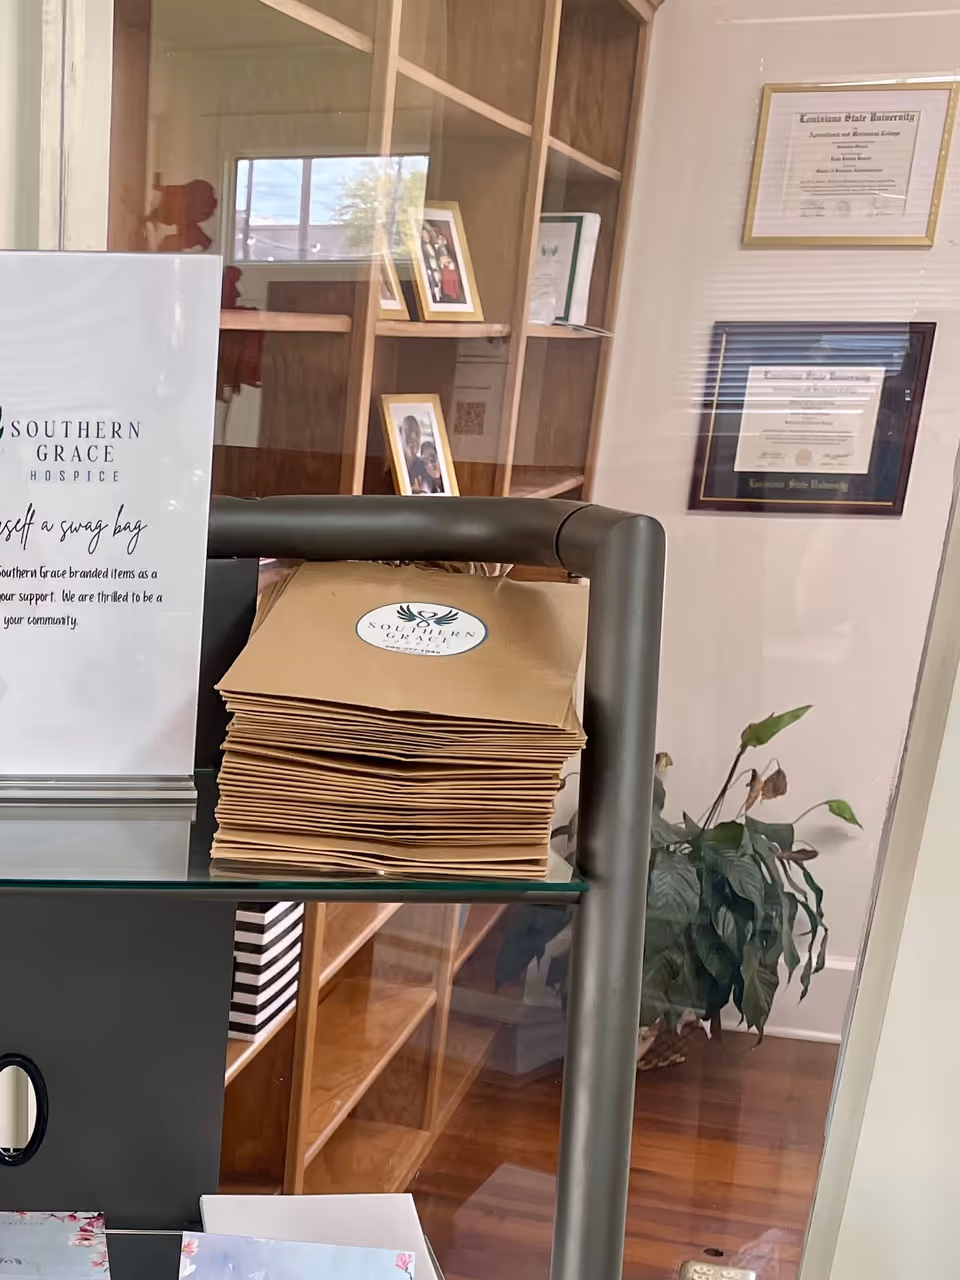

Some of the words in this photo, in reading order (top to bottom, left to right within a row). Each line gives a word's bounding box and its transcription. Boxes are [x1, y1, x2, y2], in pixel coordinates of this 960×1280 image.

[10, 420, 141, 439] SOUTHERN
[36, 444, 115, 463] GRACE
[30, 470, 119, 482] HOSPICE
[41, 520, 54, 532] a
[60, 518, 109, 555] swag
[113, 504, 148, 555] bag
[40, 565, 67, 579] Grace
[69, 565, 108, 579] branded
[111, 568, 135, 579] items
[138, 570, 149, 579] as
[151, 570, 158, 579] a
[19, 591, 56, 606] support.
[62, 589, 76, 602] We
[78, 592, 95, 602] are
[97, 591, 129, 603] thrilled
[131, 591, 141, 603] to
[143, 590, 154, 603] be
[156, 593, 163, 603] a
[3, 616, 25, 630] your
[368, 621, 476, 639] SOUTHERN
[386, 632, 448, 643] GRACE
